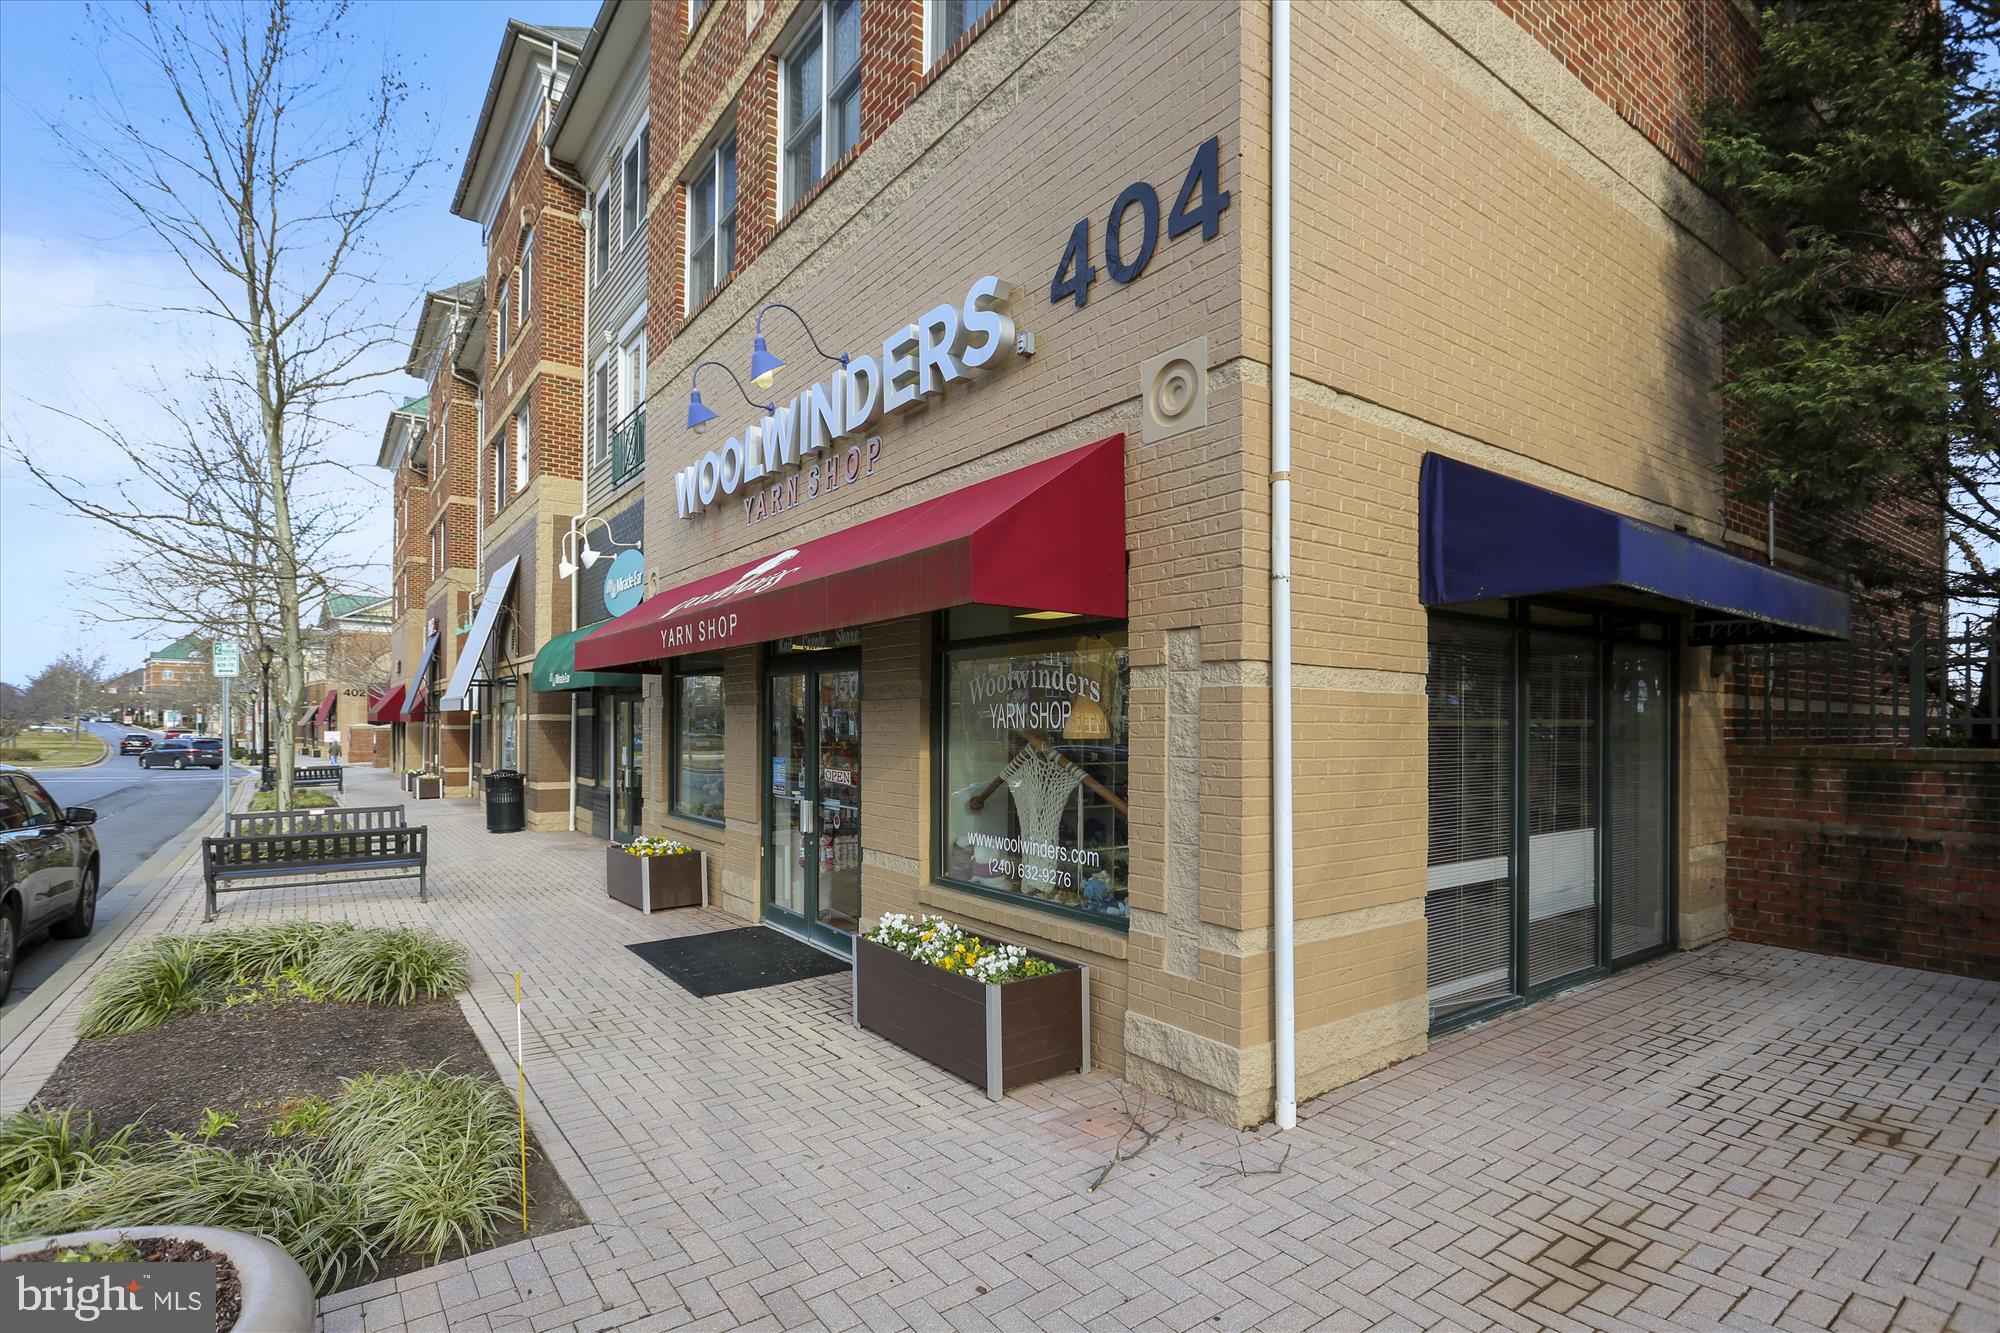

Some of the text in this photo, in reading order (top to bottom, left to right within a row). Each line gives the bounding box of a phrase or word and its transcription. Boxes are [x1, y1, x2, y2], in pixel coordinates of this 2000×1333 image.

[1050, 135, 1231, 308] 404
[674, 275, 1014, 519] WOOLWINDERS
[743, 435, 883, 526] YARN SHOP
[660, 613, 738, 648] YARN SHOP
[215, 643, 222, 654] 2
[343, 688, 366, 697] 402
[968, 660, 1100, 703] Woolwinders
[989, 701, 1072, 729] YARN SHOP
[825, 769, 851, 784] OPEN
[967, 832, 1100, 867] www.woolwinders.com
[988, 857, 1072, 888] (240) 632-9276
